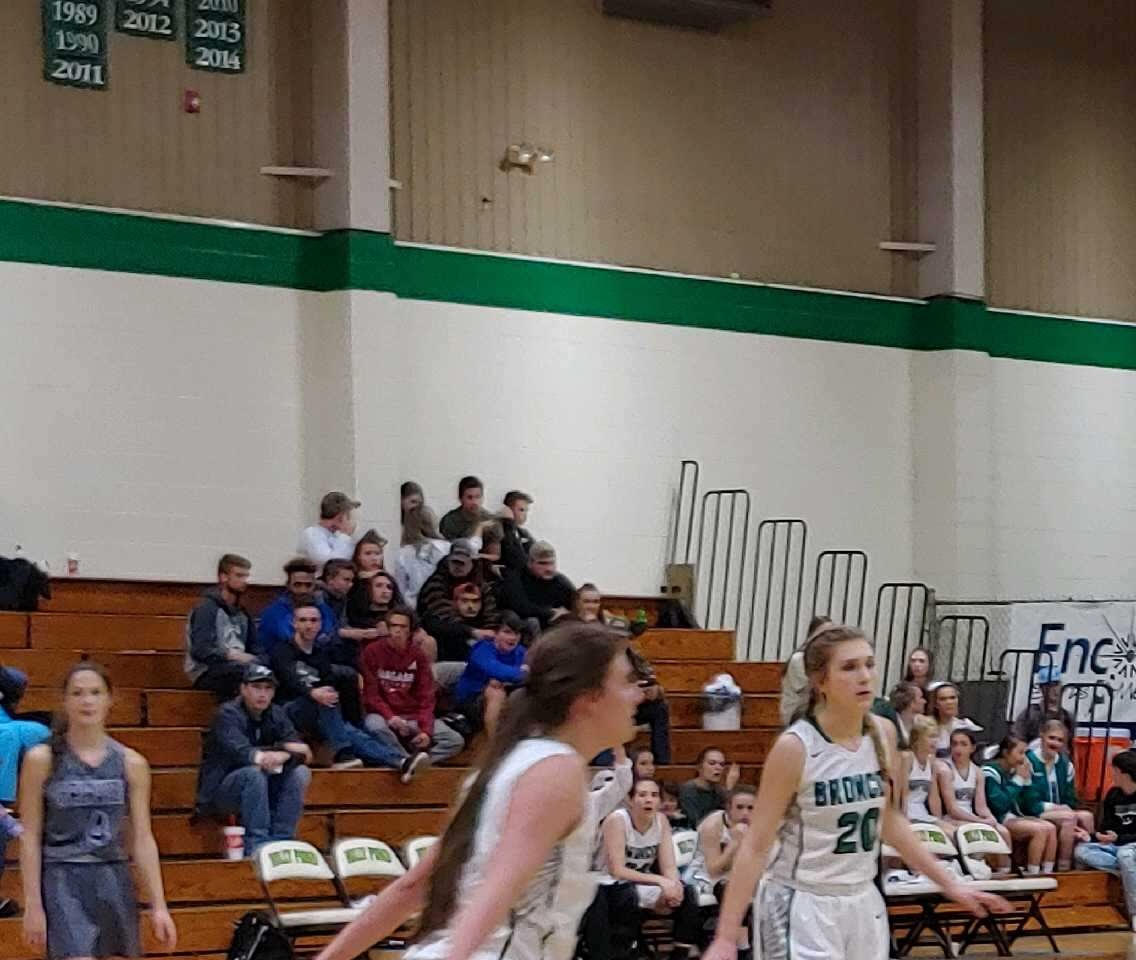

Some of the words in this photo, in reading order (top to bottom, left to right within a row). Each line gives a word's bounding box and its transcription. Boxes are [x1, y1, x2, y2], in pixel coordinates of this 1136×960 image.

[55, 0, 97, 25] 1989
[123, 9, 172, 35] 2012
[194, 18, 241, 43] 2013
[195, 47, 241, 70] 2014
[51, 59, 104, 85] 2011
